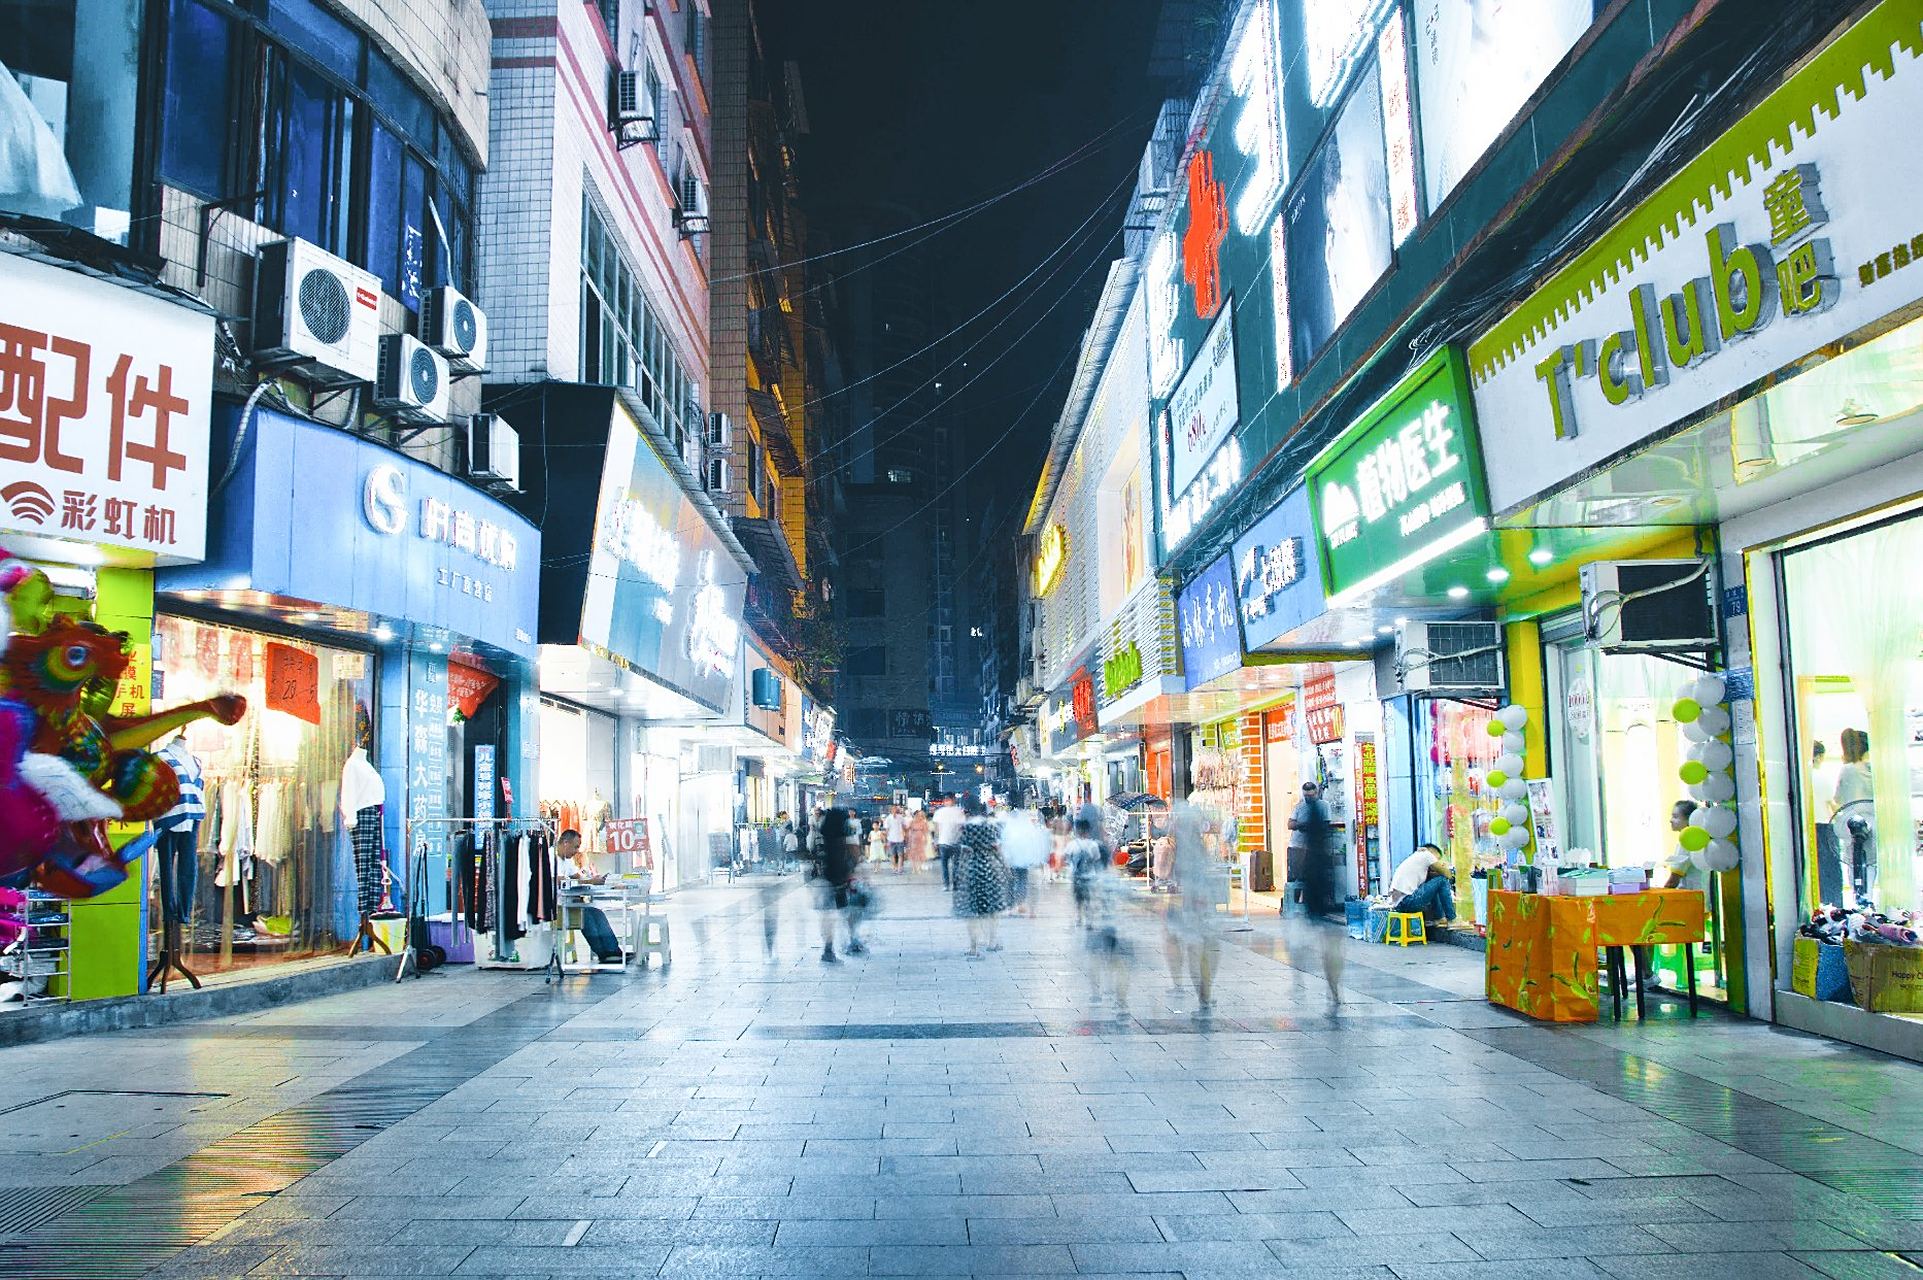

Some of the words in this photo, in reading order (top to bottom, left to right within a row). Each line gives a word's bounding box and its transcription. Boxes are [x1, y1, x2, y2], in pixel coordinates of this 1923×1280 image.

[1763, 164, 1832, 318] 童吧
[0, 322, 189, 491] 配件
[1356, 399, 1460, 524] 植物医生
[61, 489, 177, 545] 彩虹机
[610, 829, 635, 851] 10
